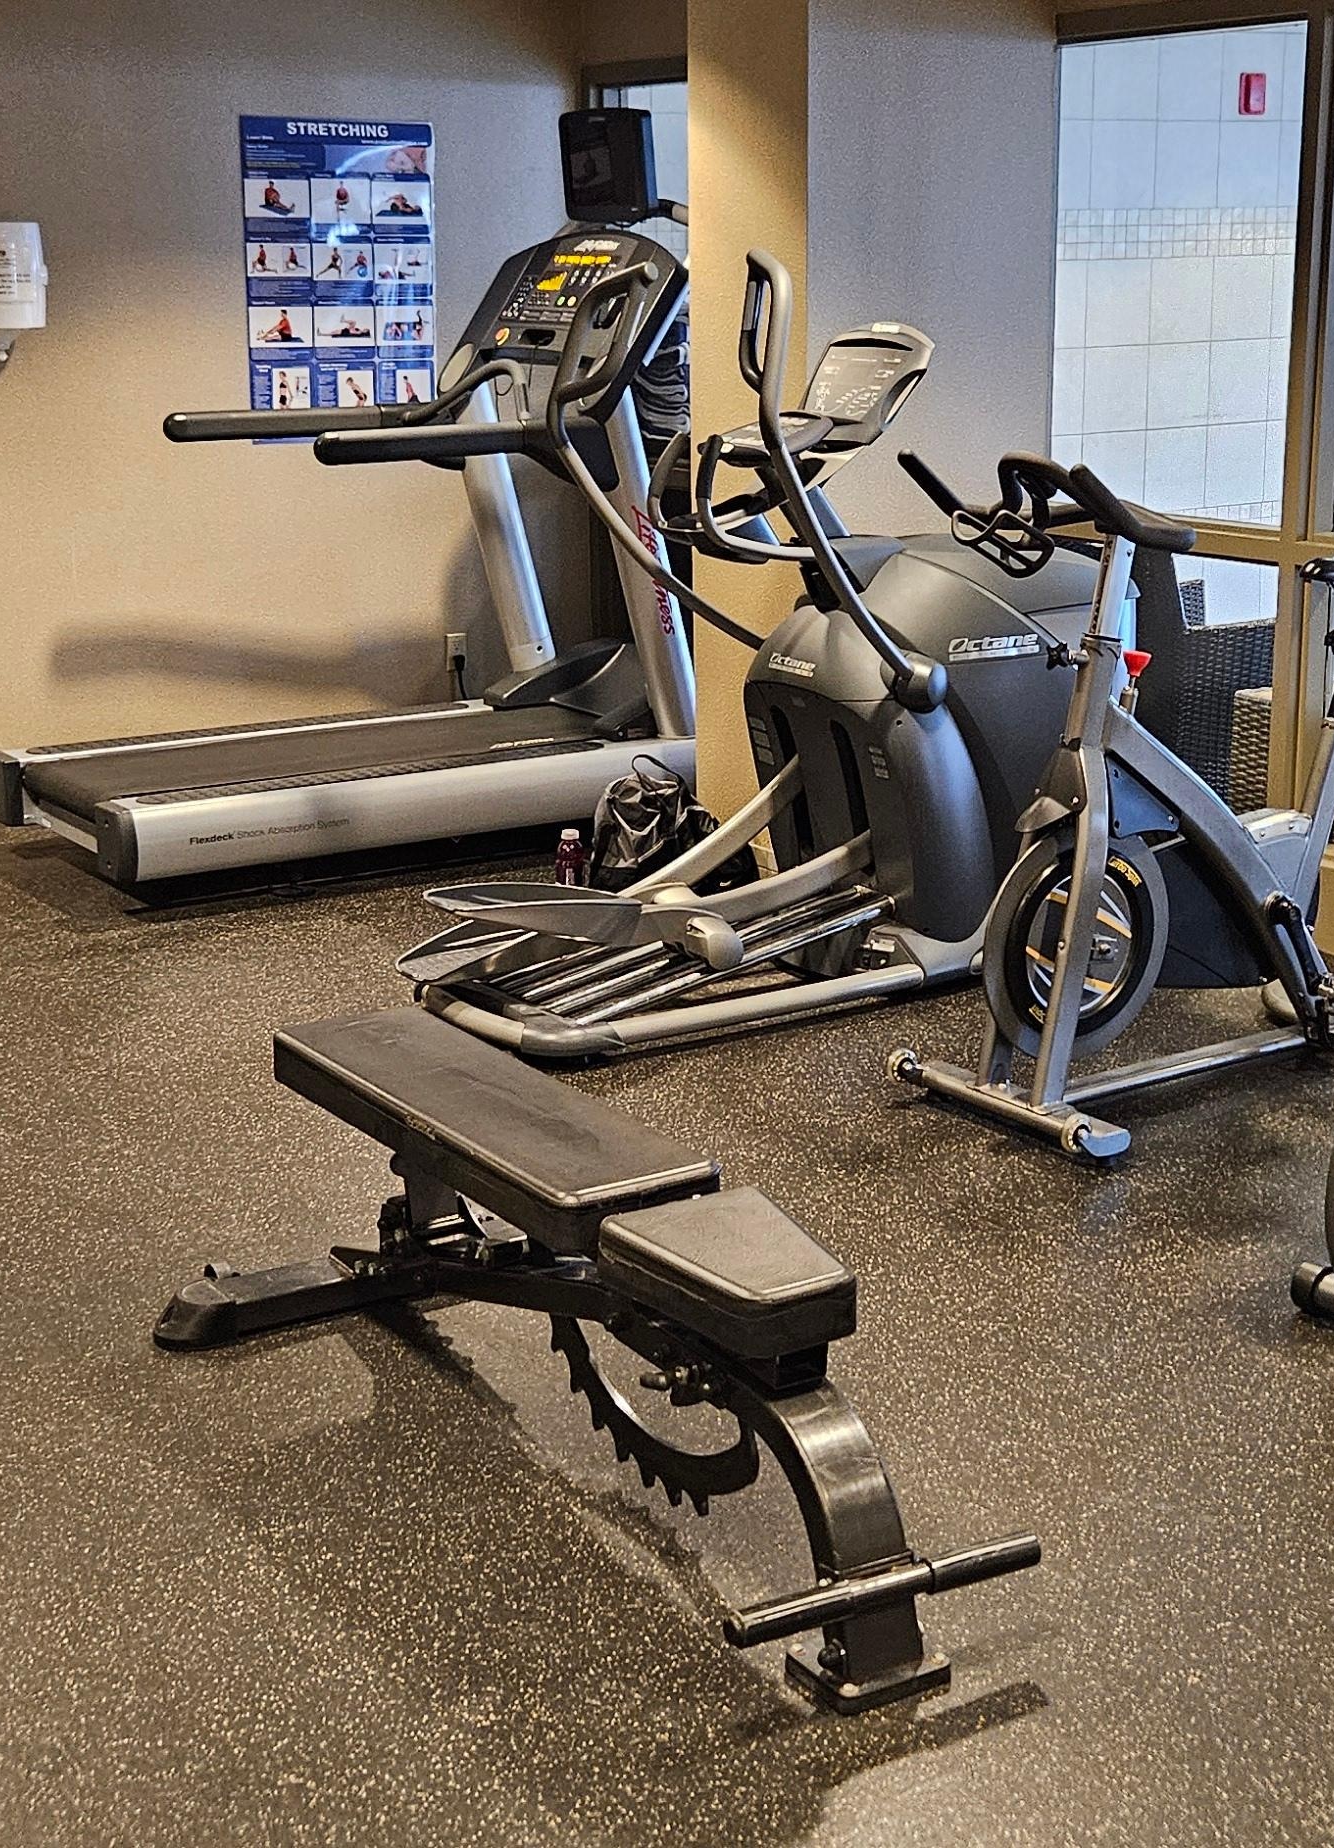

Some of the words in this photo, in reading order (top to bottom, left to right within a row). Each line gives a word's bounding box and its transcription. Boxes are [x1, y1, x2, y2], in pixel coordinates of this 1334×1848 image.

[286, 122, 389, 138] STRETCHING
[949, 633, 1038, 653] Octane
[770, 652, 817, 671] Octane
[317, 818, 350, 830] System
